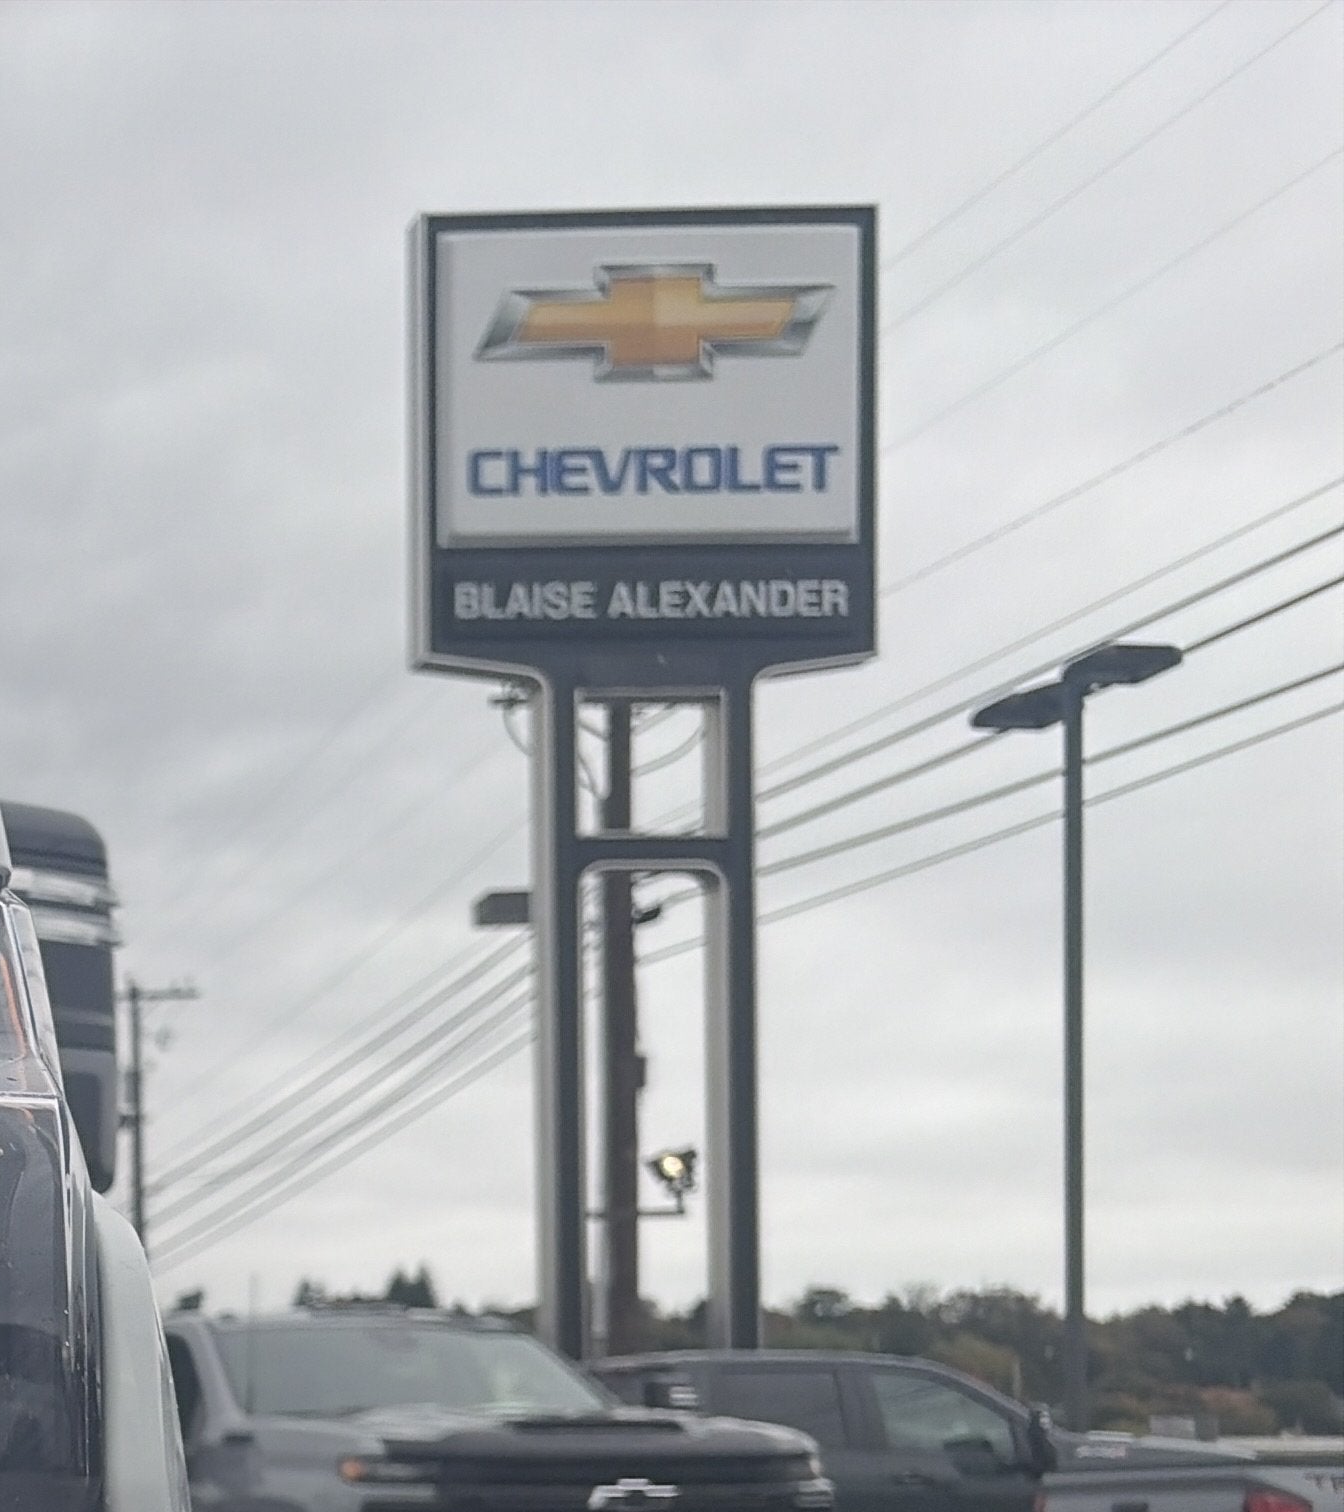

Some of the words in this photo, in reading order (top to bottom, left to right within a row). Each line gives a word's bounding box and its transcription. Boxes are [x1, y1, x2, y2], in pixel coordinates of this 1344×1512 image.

[467, 444, 840, 496] CHEVROLET
[453, 580, 598, 621] BLAISE
[606, 579, 850, 619] ALEXANDER
